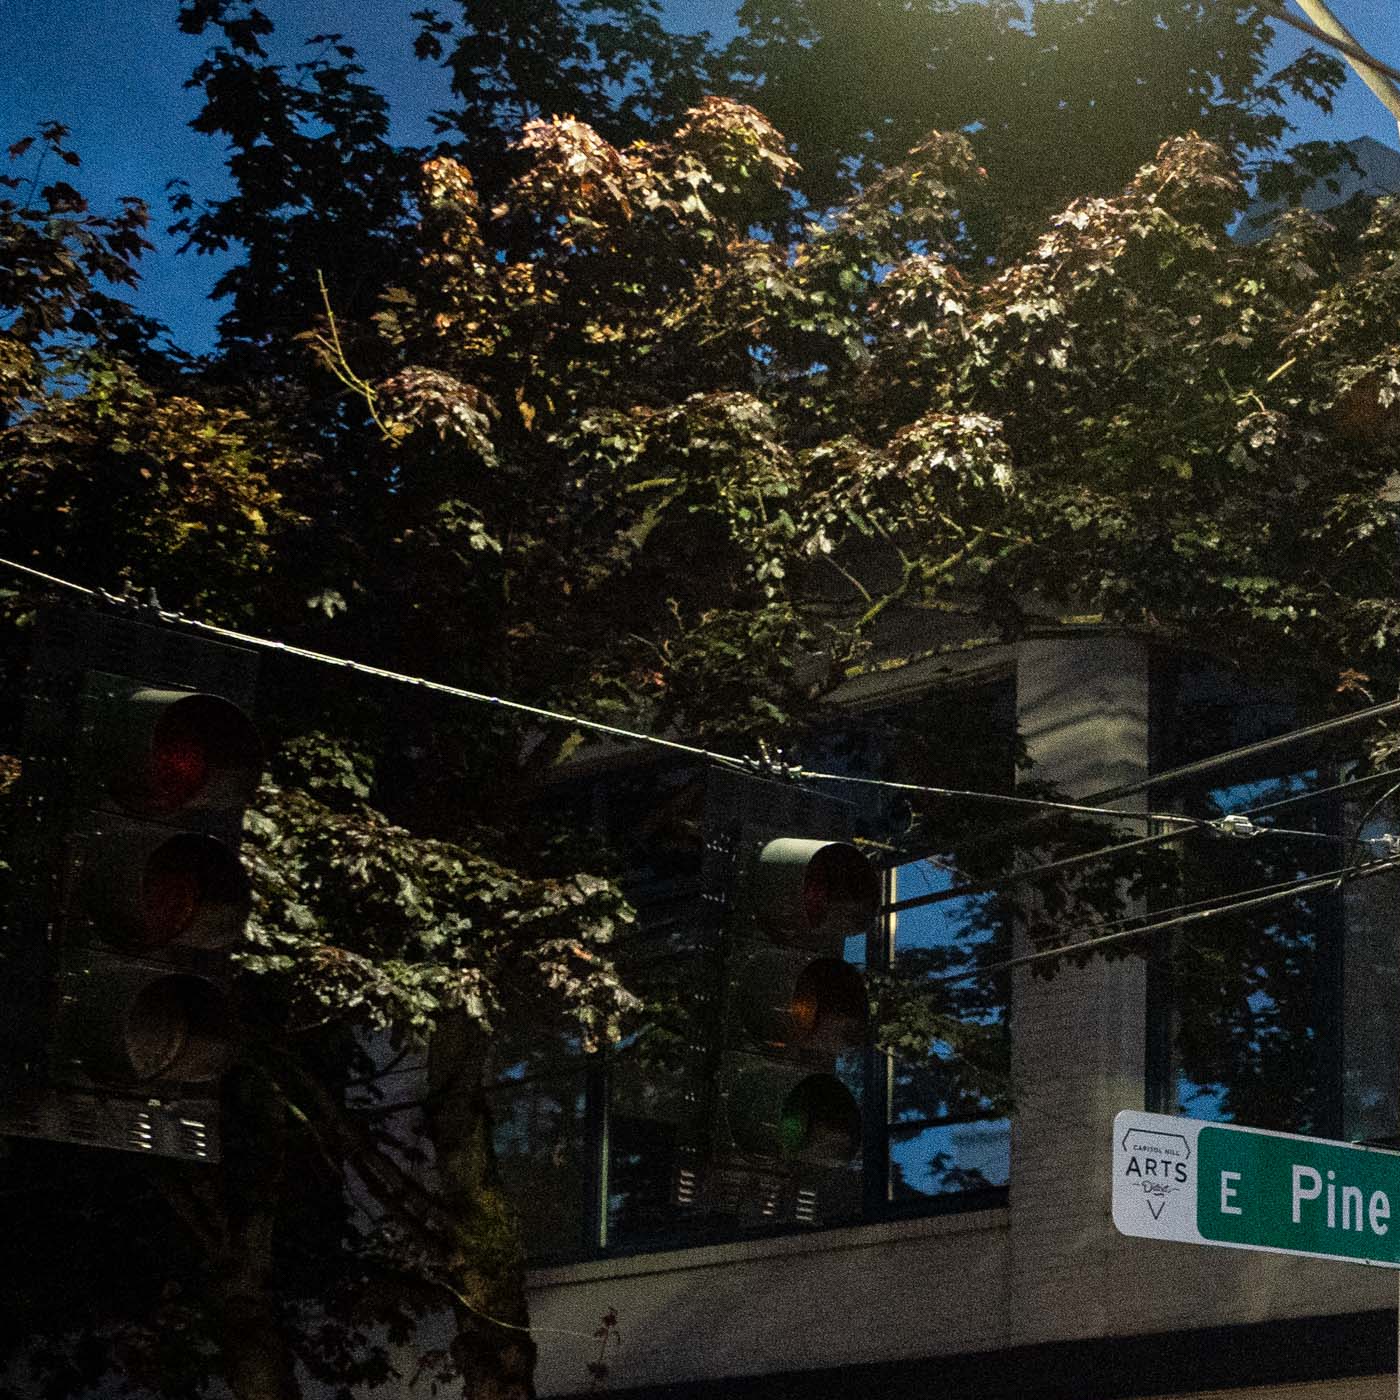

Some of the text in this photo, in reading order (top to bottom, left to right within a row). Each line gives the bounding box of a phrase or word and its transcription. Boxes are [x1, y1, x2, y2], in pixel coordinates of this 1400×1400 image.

[1125, 1155, 1188, 1183] ARTS
[1220, 1171, 1242, 1216] E
[1291, 1164, 1391, 1236] Pine
